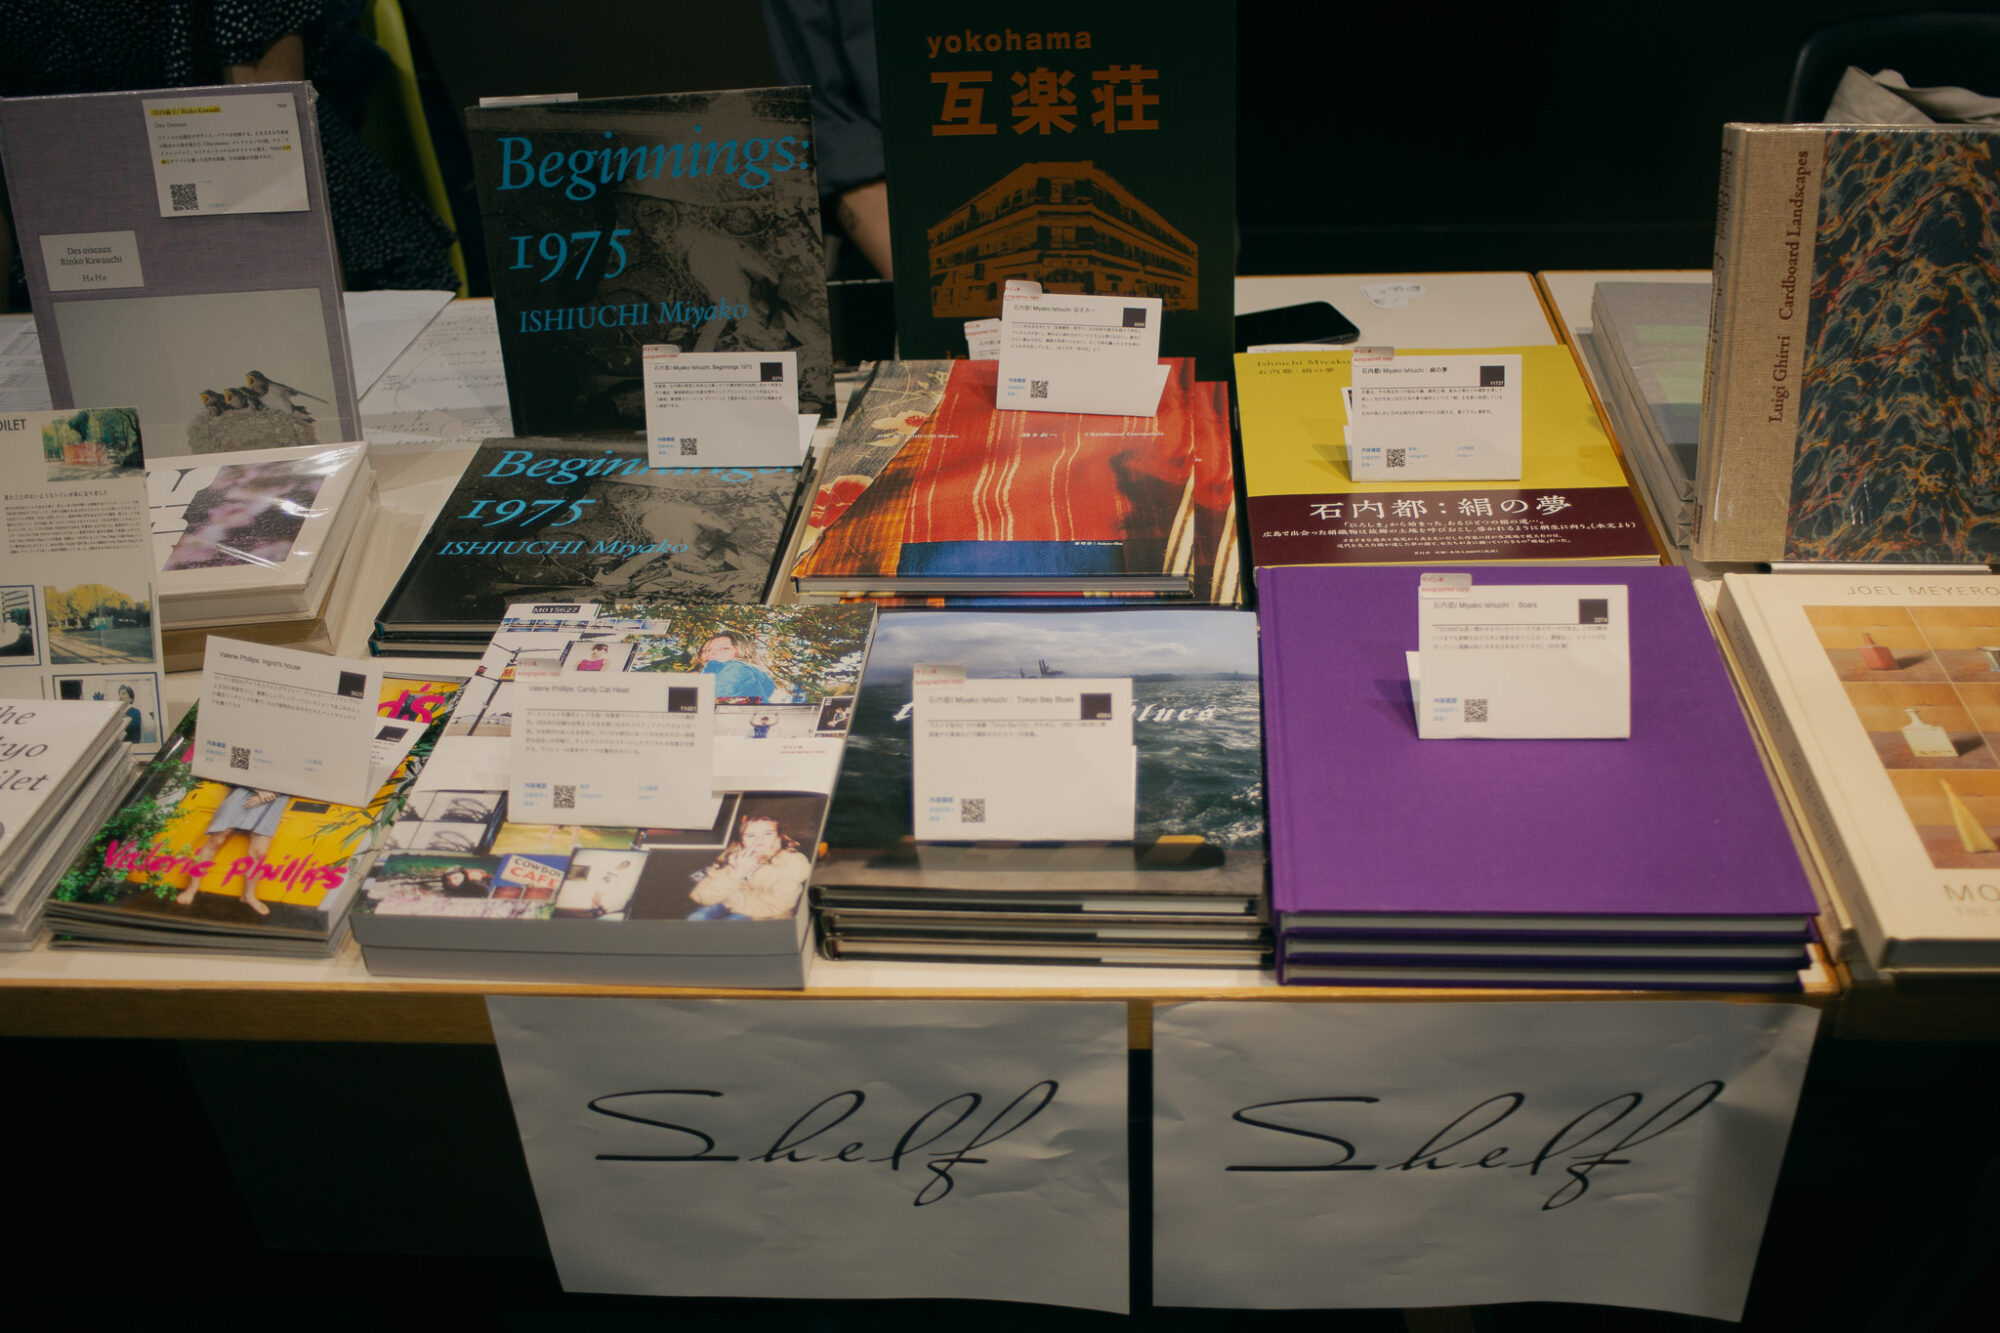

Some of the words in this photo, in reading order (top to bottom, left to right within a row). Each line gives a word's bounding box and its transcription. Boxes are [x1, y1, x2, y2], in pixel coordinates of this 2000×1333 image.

[927, 28, 1093, 59] yokohama
[930, 64, 1160, 136] 互楽荘
[497, 124, 810, 200] Beginnings:
[1786, 150, 1812, 237] Landscapes
[60, 257, 84, 266] Rinko
[85, 255, 123, 265] Kawauchi
[67, 247, 82, 255] Des
[83, 246, 112, 255] oiseaux
[508, 228, 632, 283] 1975
[1778, 241, 1801, 321] Cardboard
[519, 302, 649, 333] ISHIUCHI
[659, 297, 748, 328] Miyako
[1772, 335, 1791, 383] Ghirri
[1768, 384, 1790, 423] Luigi
[457, 499, 597, 528] 1975
[438, 540, 586, 556] ISHIUCHI
[590, 538, 689, 558] Miyako
[1847, 585, 1900, 596] JOEL
[533, 605, 579, 614] M015627
[1459, 601, 1482, 610] Miyako
[577, 685, 598, 694] Candy
[613, 686, 630, 694] Head
[0, 706, 36, 725] he
[1129, 699, 1218, 722] lues
[0, 736, 48, 761] yo
[104, 840, 216, 878] Valerie
[515, 858, 562, 878] COWBOY
[510, 867, 559, 889] CAFE
[586, 1078, 1059, 1206] Shelf
[1224, 1080, 1725, 1211] Shelf
